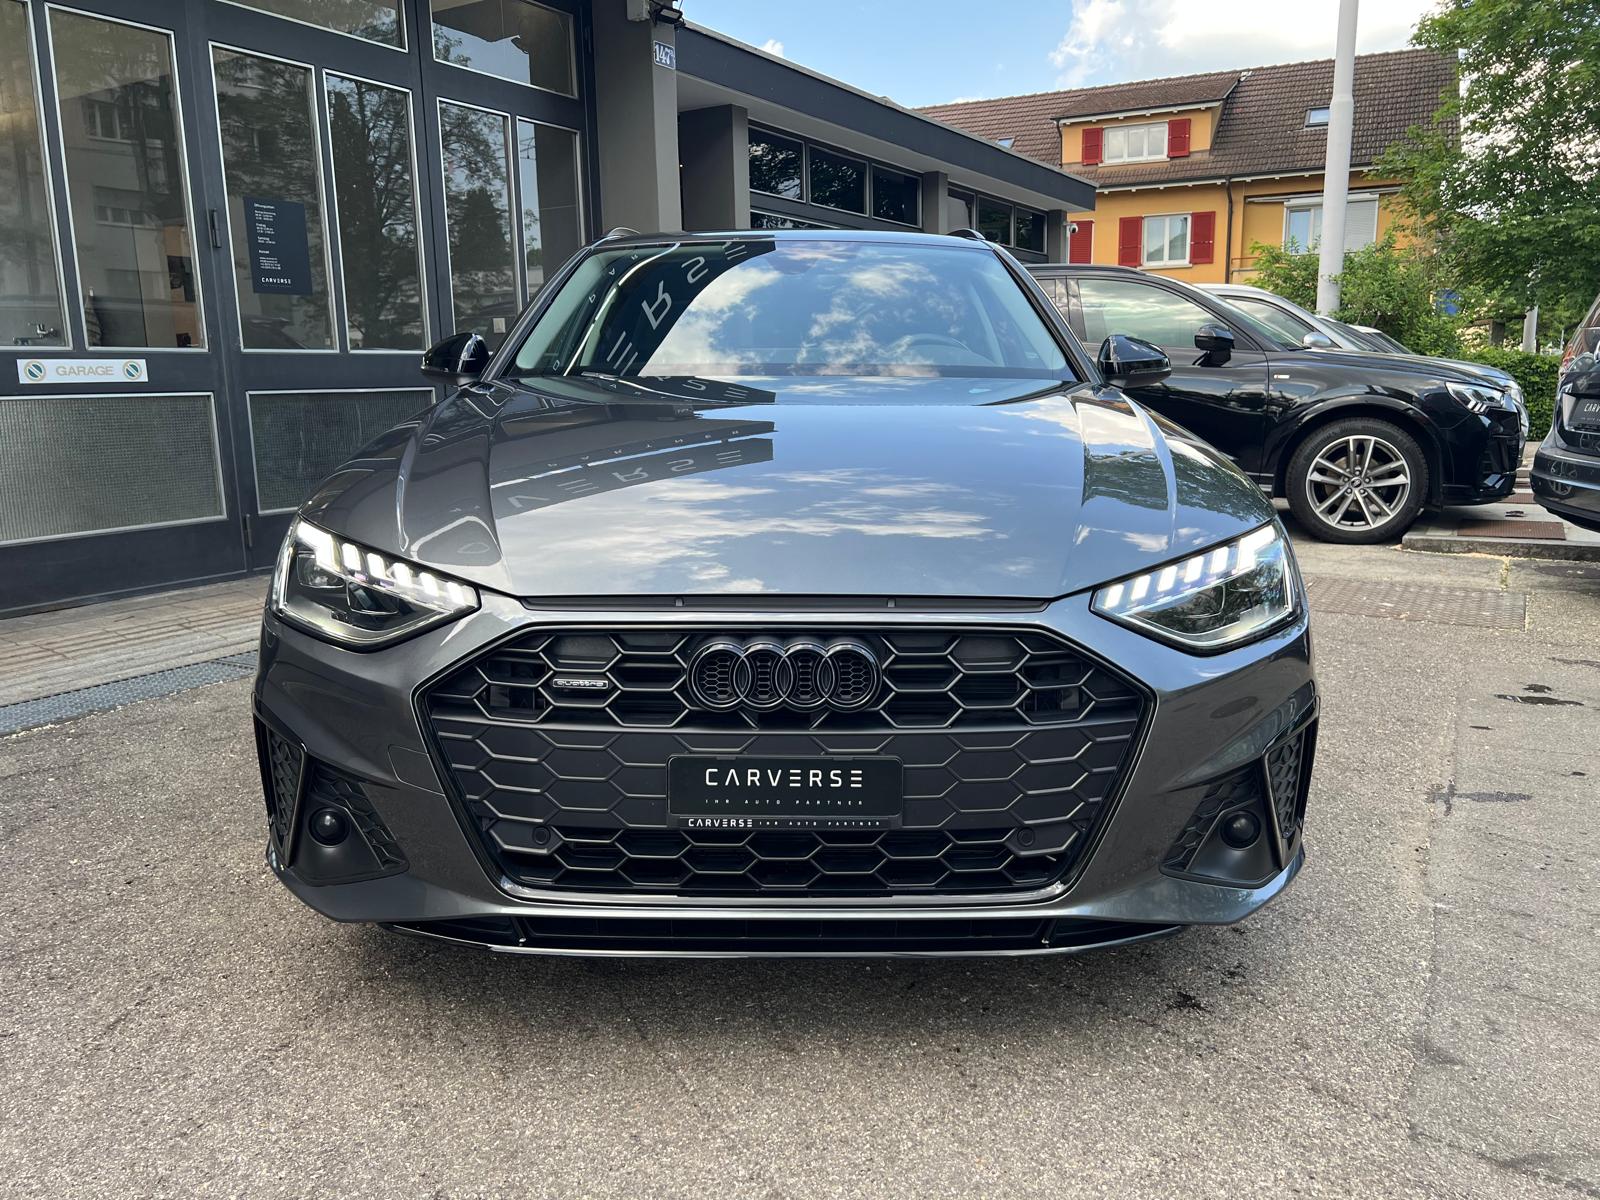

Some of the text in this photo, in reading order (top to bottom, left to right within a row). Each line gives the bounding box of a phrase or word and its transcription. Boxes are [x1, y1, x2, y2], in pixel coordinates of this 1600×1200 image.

[55, 365, 115, 377] GARAGE
[556, 680, 605, 688] quattro
[705, 768, 863, 788] CARVERSE
[687, 818, 753, 828] CARVERSE
